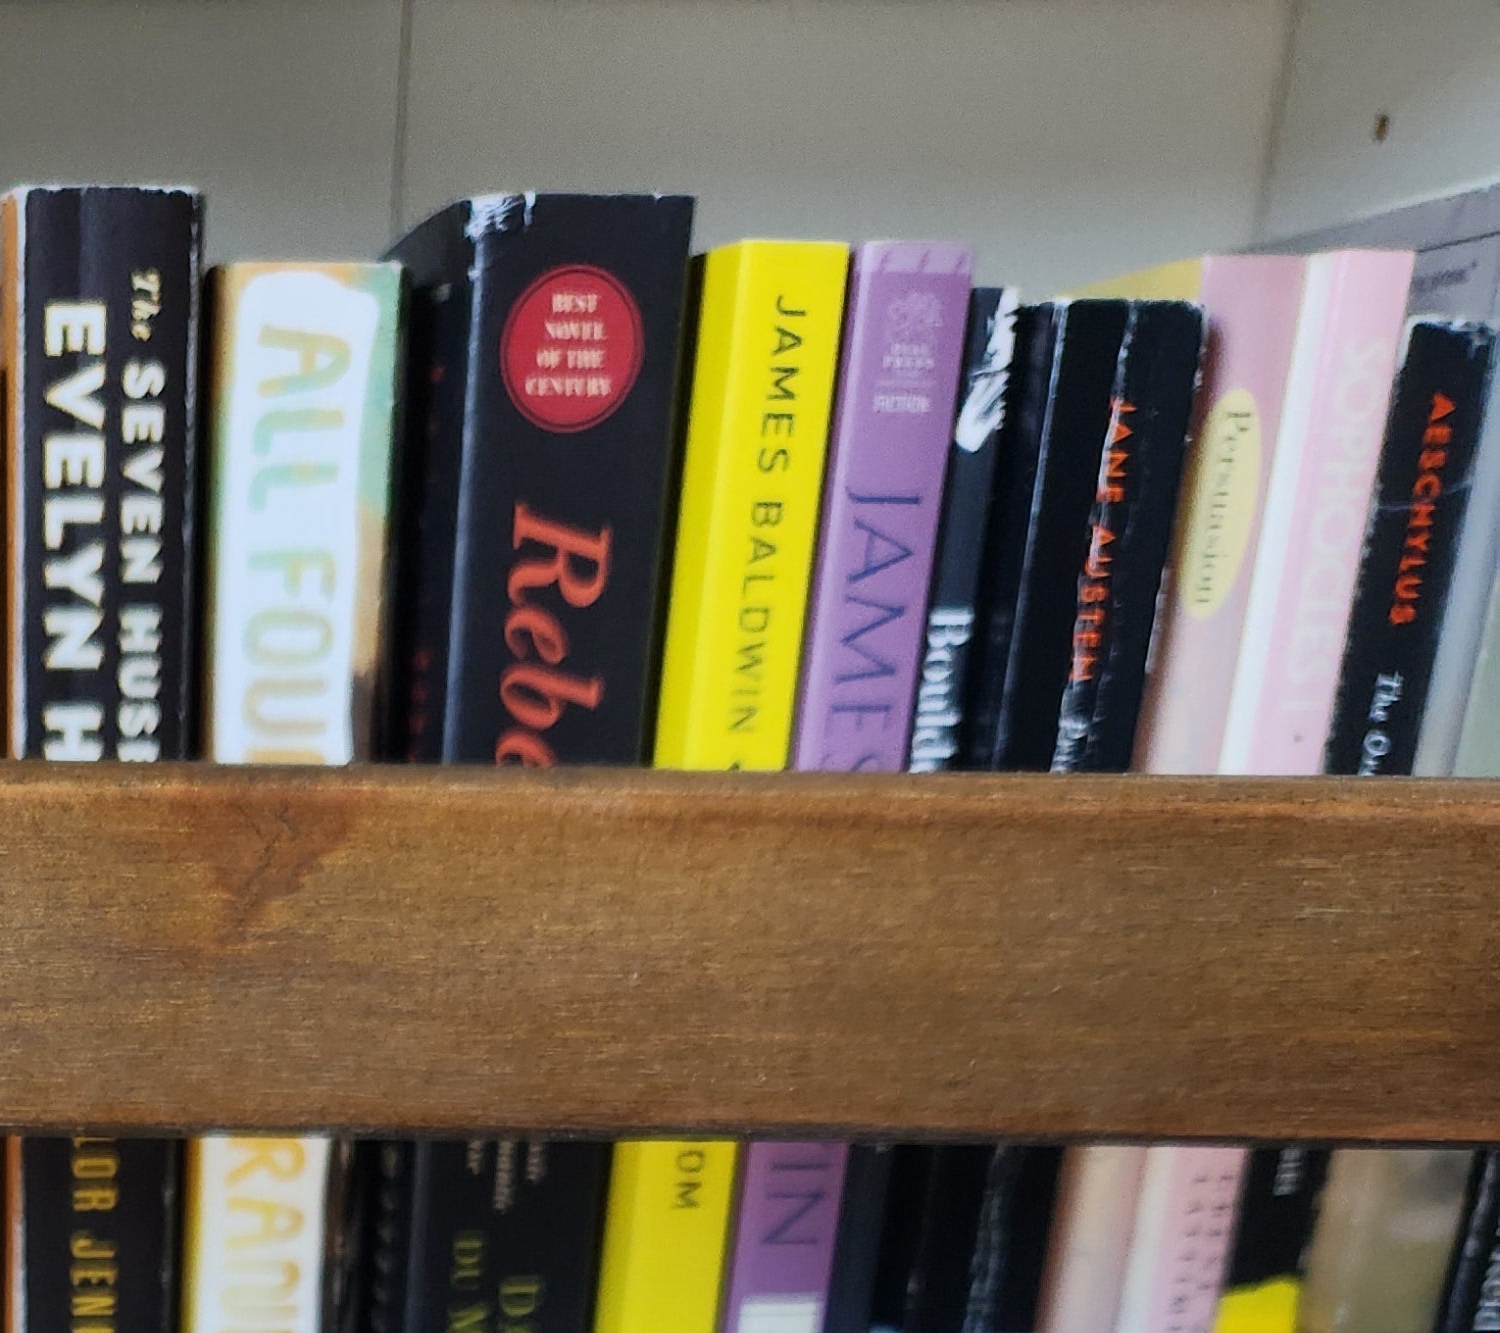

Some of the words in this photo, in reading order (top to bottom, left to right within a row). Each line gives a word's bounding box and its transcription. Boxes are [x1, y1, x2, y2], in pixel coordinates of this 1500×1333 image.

[130, 266, 164, 342] The
[545, 320, 607, 341] NOVEL
[553, 293, 599, 313] BEST
[525, 376, 612, 397] CENTURY
[536, 349, 561, 369] OF
[567, 349, 606, 370] THE
[757, 294, 806, 476] JAMES
[252, 322, 351, 515] ALL
[1096, 398, 1134, 504] JANE
[42, 303, 107, 672] EVELYN
[121, 360, 166, 585] SEVEN
[1194, 410, 1253, 604] Persuasion
[1289, 340, 1386, 678] SOPHOCLES
[1389, 392, 1457, 626] AESCHYLUS
[728, 500, 785, 734] BALDWIN
[1068, 522, 1116, 682] AUSTEN
[42, 701, 105, 762] H
[1369, 671, 1405, 723] The
[673, 1149, 706, 1211] OM
[761, 1160, 833, 1246] IN
